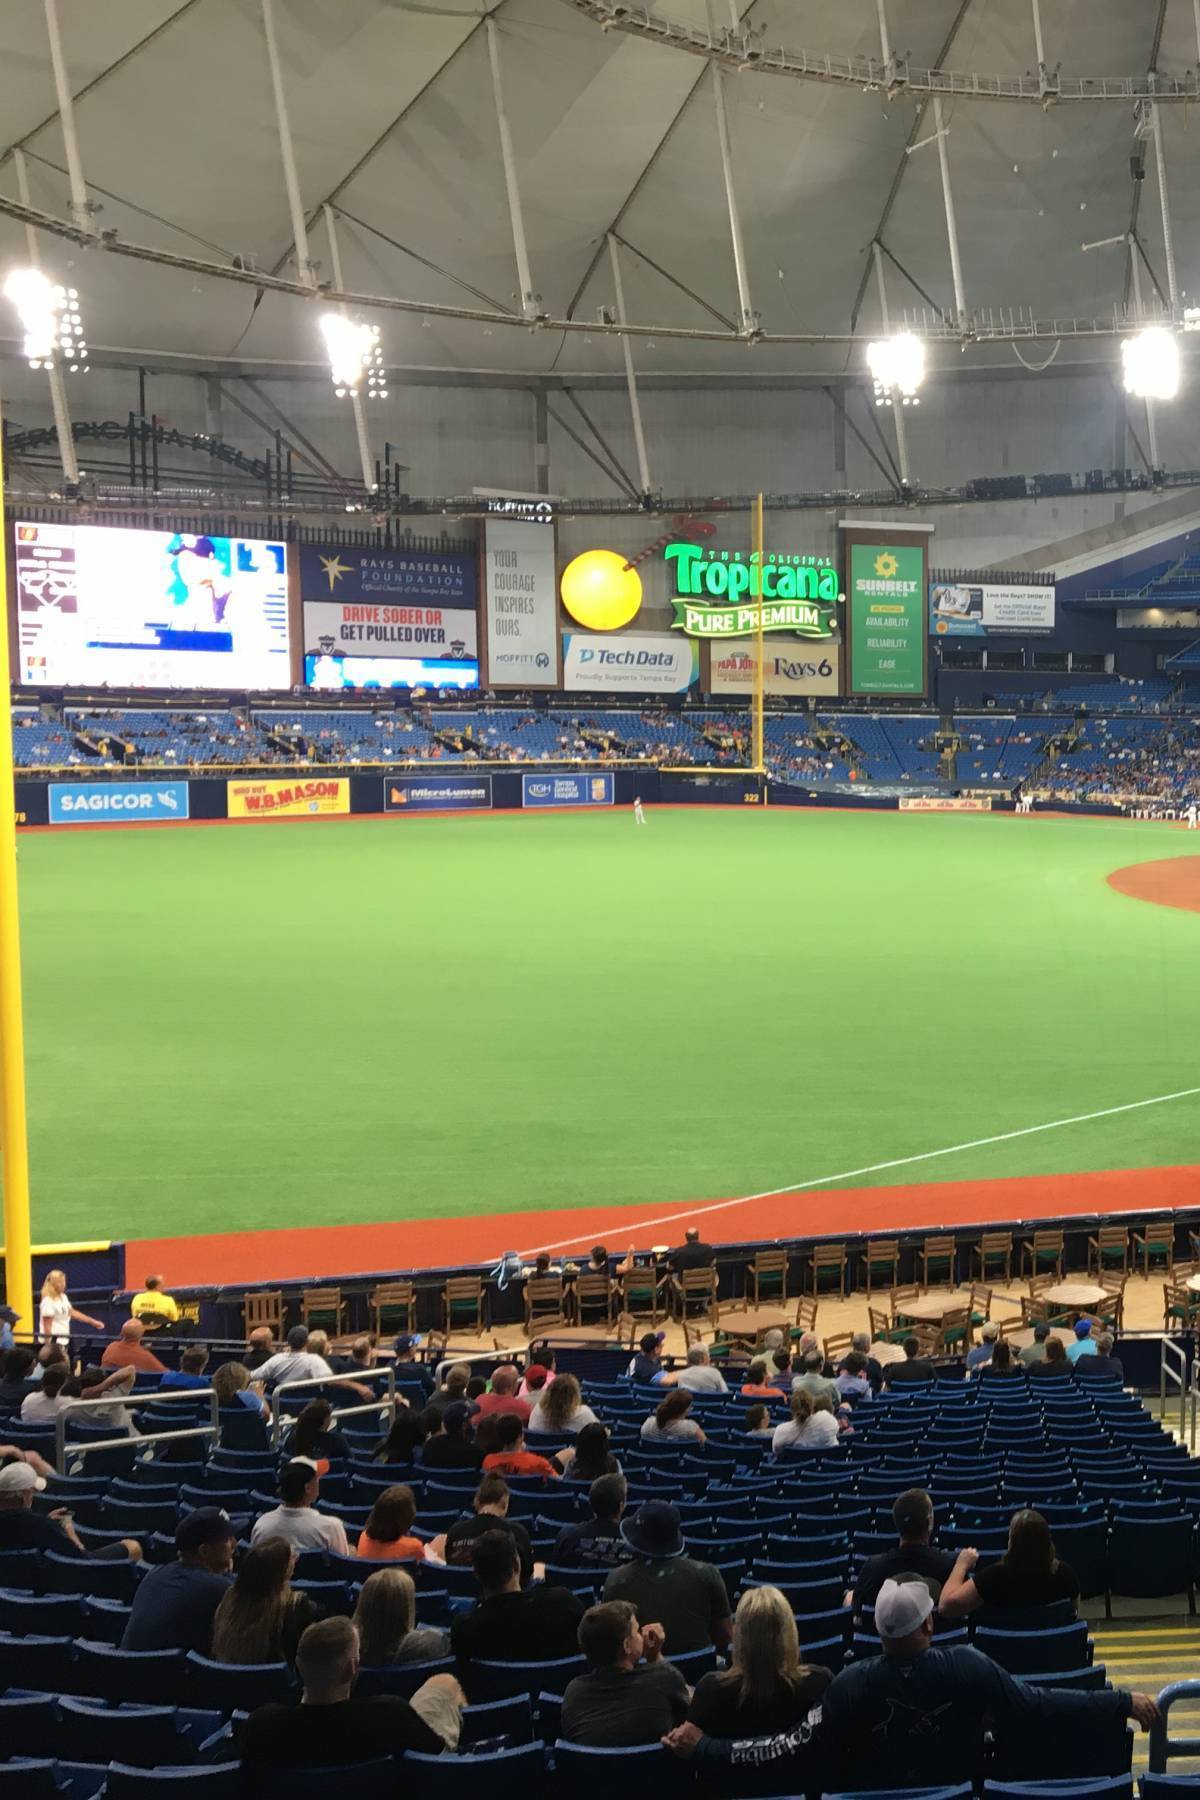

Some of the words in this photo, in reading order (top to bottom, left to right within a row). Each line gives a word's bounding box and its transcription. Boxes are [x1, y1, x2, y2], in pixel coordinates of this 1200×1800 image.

[360, 558, 394, 569] RAYS
[400, 561, 463, 574] BASEBALL
[493, 550, 517, 568] YOUR
[709, 551, 741, 561] THE
[769, 555, 832, 567] ORIGINAL
[362, 570, 463, 586] FOUNDATION
[665, 543, 838, 601] Tropicana
[494, 572, 535, 592] COURAGE
[856, 579, 916, 592] SUNBELT
[495, 596, 535, 615] INSPIRES
[343, 606, 380, 623] DRIVE
[382, 607, 423, 625] SOBER
[425, 609, 442, 626] OR
[686, 608, 734, 632] PURE
[737, 605, 819, 631] PREMIUM
[865, 617, 909, 628] AVAILABILITY
[340, 624, 364, 640] GET
[366, 625, 412, 642] PULLED
[414, 627, 445, 643] OVER
[495, 618, 522, 637] OURS.
[867, 638, 908, 649] RELIABILITY
[496, 654, 534, 664] MOFFITT
[598, 650, 636, 665] Tech
[637, 651, 673, 666] Data
[878, 659, 896, 669] EASE
[818, 659, 832, 677] 6
[576, 673, 602, 681] Proudly
[411, 788, 485, 797] MicroLumen
[533, 784, 551, 793] TGH
[61, 793, 153, 810] SAGICOR
[744, 793, 759, 803] 322
[730, 1721, 812, 1767] Columbia
